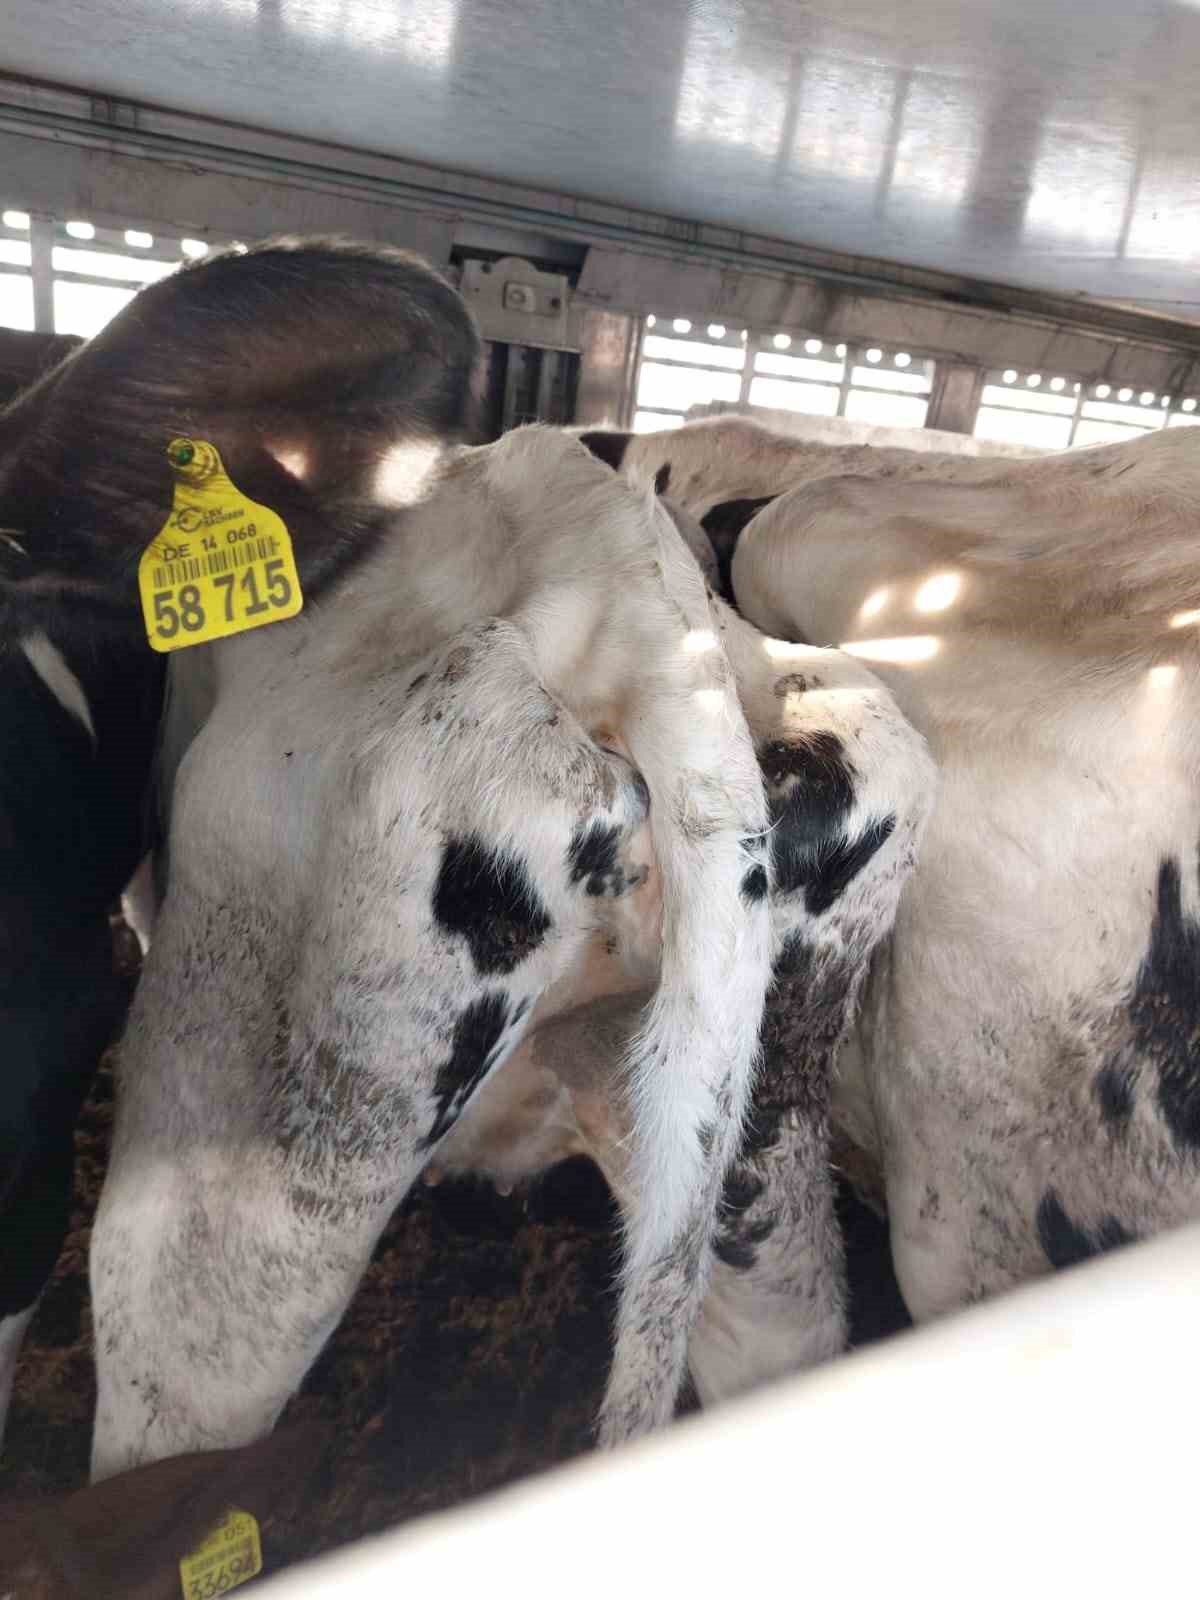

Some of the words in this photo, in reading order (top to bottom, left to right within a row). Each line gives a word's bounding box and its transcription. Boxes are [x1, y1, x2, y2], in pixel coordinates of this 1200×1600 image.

[164, 543, 190, 561] DE
[202, 533, 217, 552] 14
[227, 523, 256, 544] 068
[153, 585, 206, 638] 58
[213, 559, 292, 621] 715
